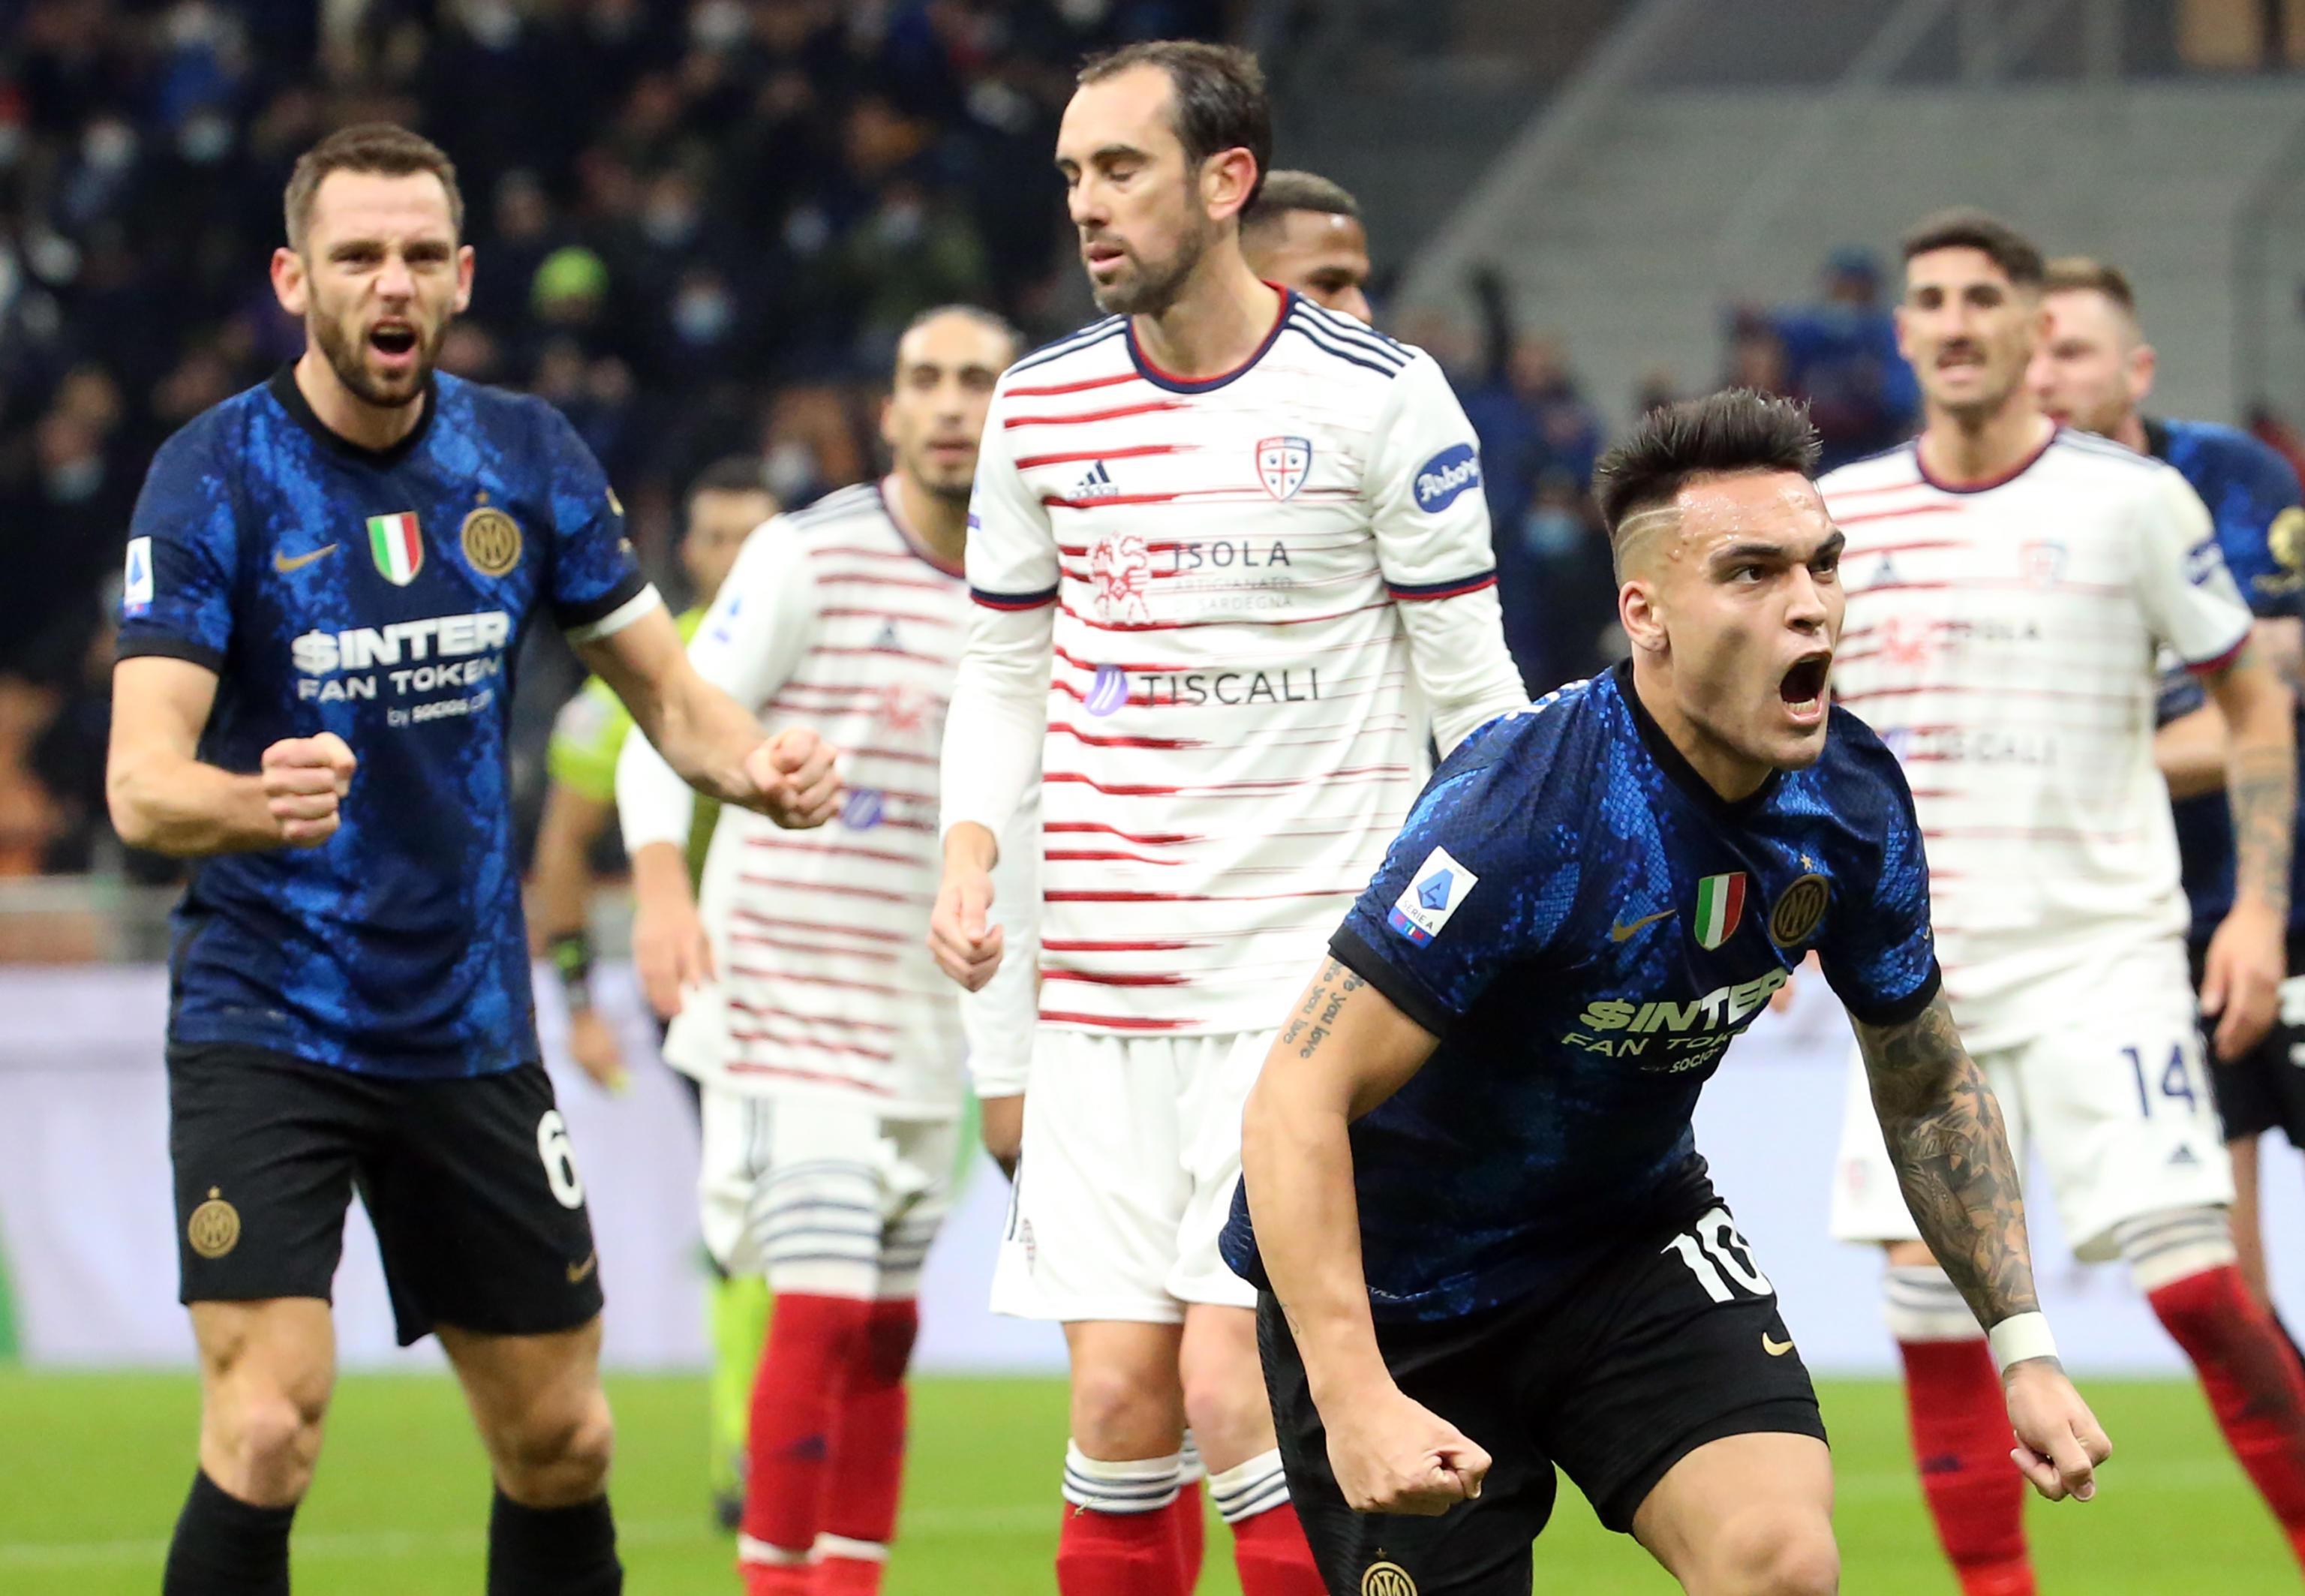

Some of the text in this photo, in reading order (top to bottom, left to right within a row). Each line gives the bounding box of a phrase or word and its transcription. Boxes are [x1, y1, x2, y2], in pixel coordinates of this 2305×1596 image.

[1174, 540, 1291, 571] ISOLA
[291, 611, 509, 675] $INTER
[297, 654, 503, 702] FAN TOKEN
[1140, 668, 1318, 707] TISCALI
[387, 706, 409, 727] by
[1402, 900, 1434, 930] SERIE A
[1302, 986, 1326, 1014] you
[1321, 992, 1346, 1025] you
[1300, 1026, 1330, 1059] love
[1561, 1032, 1650, 1057] FAN
[2120, 1043, 2196, 1117] 14
[537, 1109, 585, 1210] 6
[1660, 1207, 1773, 1303] 10
